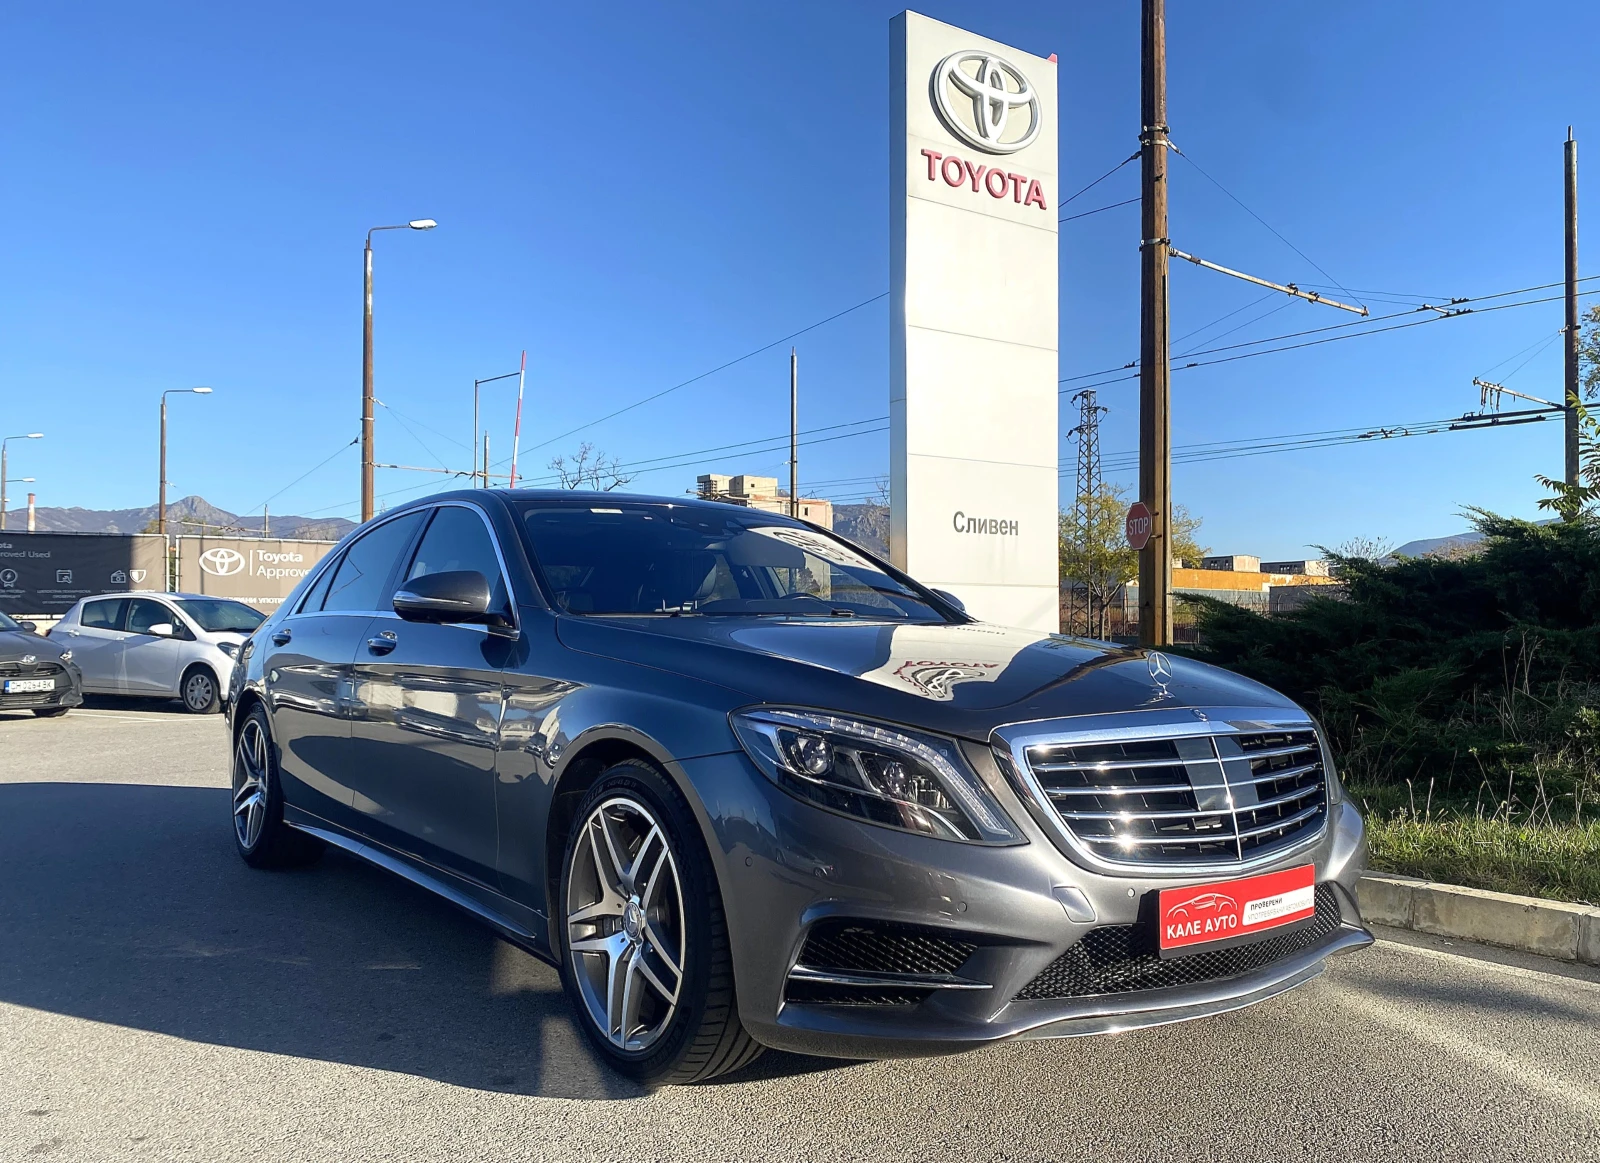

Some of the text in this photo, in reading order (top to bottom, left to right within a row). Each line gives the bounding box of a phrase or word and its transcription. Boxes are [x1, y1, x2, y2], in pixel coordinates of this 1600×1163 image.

[921, 148, 1047, 210] TOYOTA
[953, 511, 1019, 536] Сливен
[1128, 516, 1149, 536] STOP
[256, 549, 304, 564] Toyota
[1250, 897, 1283, 911] ПРОВЕРЕНИ
[1166, 913, 1238, 940] КАЛЕ АУТО
